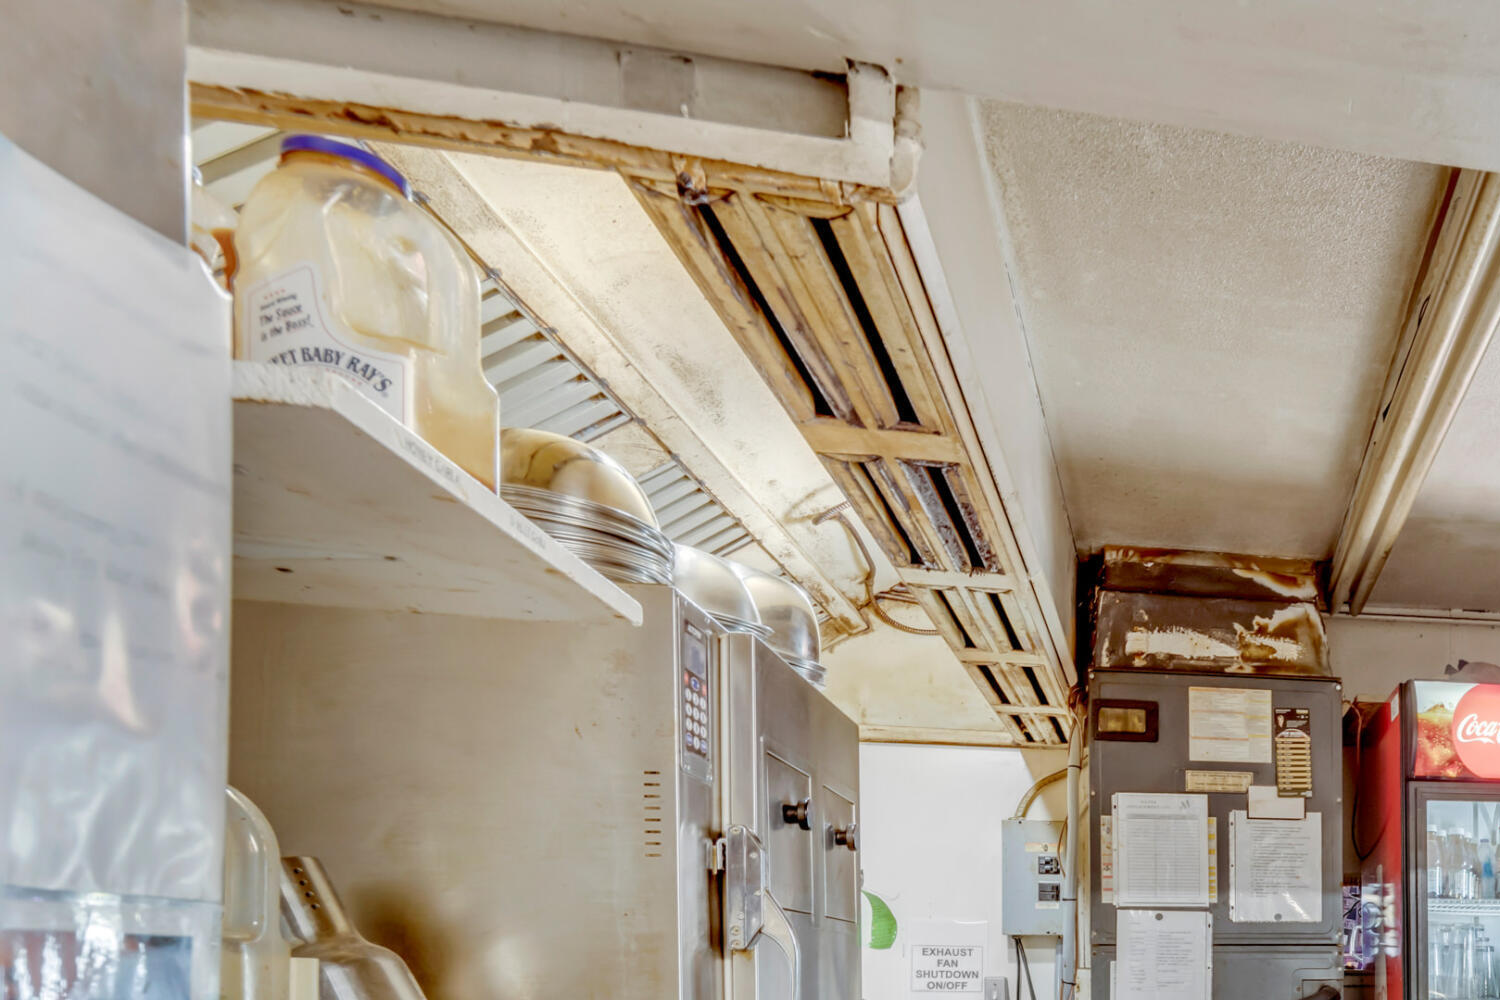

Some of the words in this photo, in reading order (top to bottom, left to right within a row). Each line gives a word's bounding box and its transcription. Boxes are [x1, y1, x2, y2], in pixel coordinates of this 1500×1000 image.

[300, 347, 344, 366] BABY
[346, 355, 393, 393] RAY'S
[922, 947, 974, 957] EXHAUST
[937, 959, 959, 968] FAN
[915, 970, 979, 979] SHUTDOWN
[927, 981, 968, 990] ON/OFF
